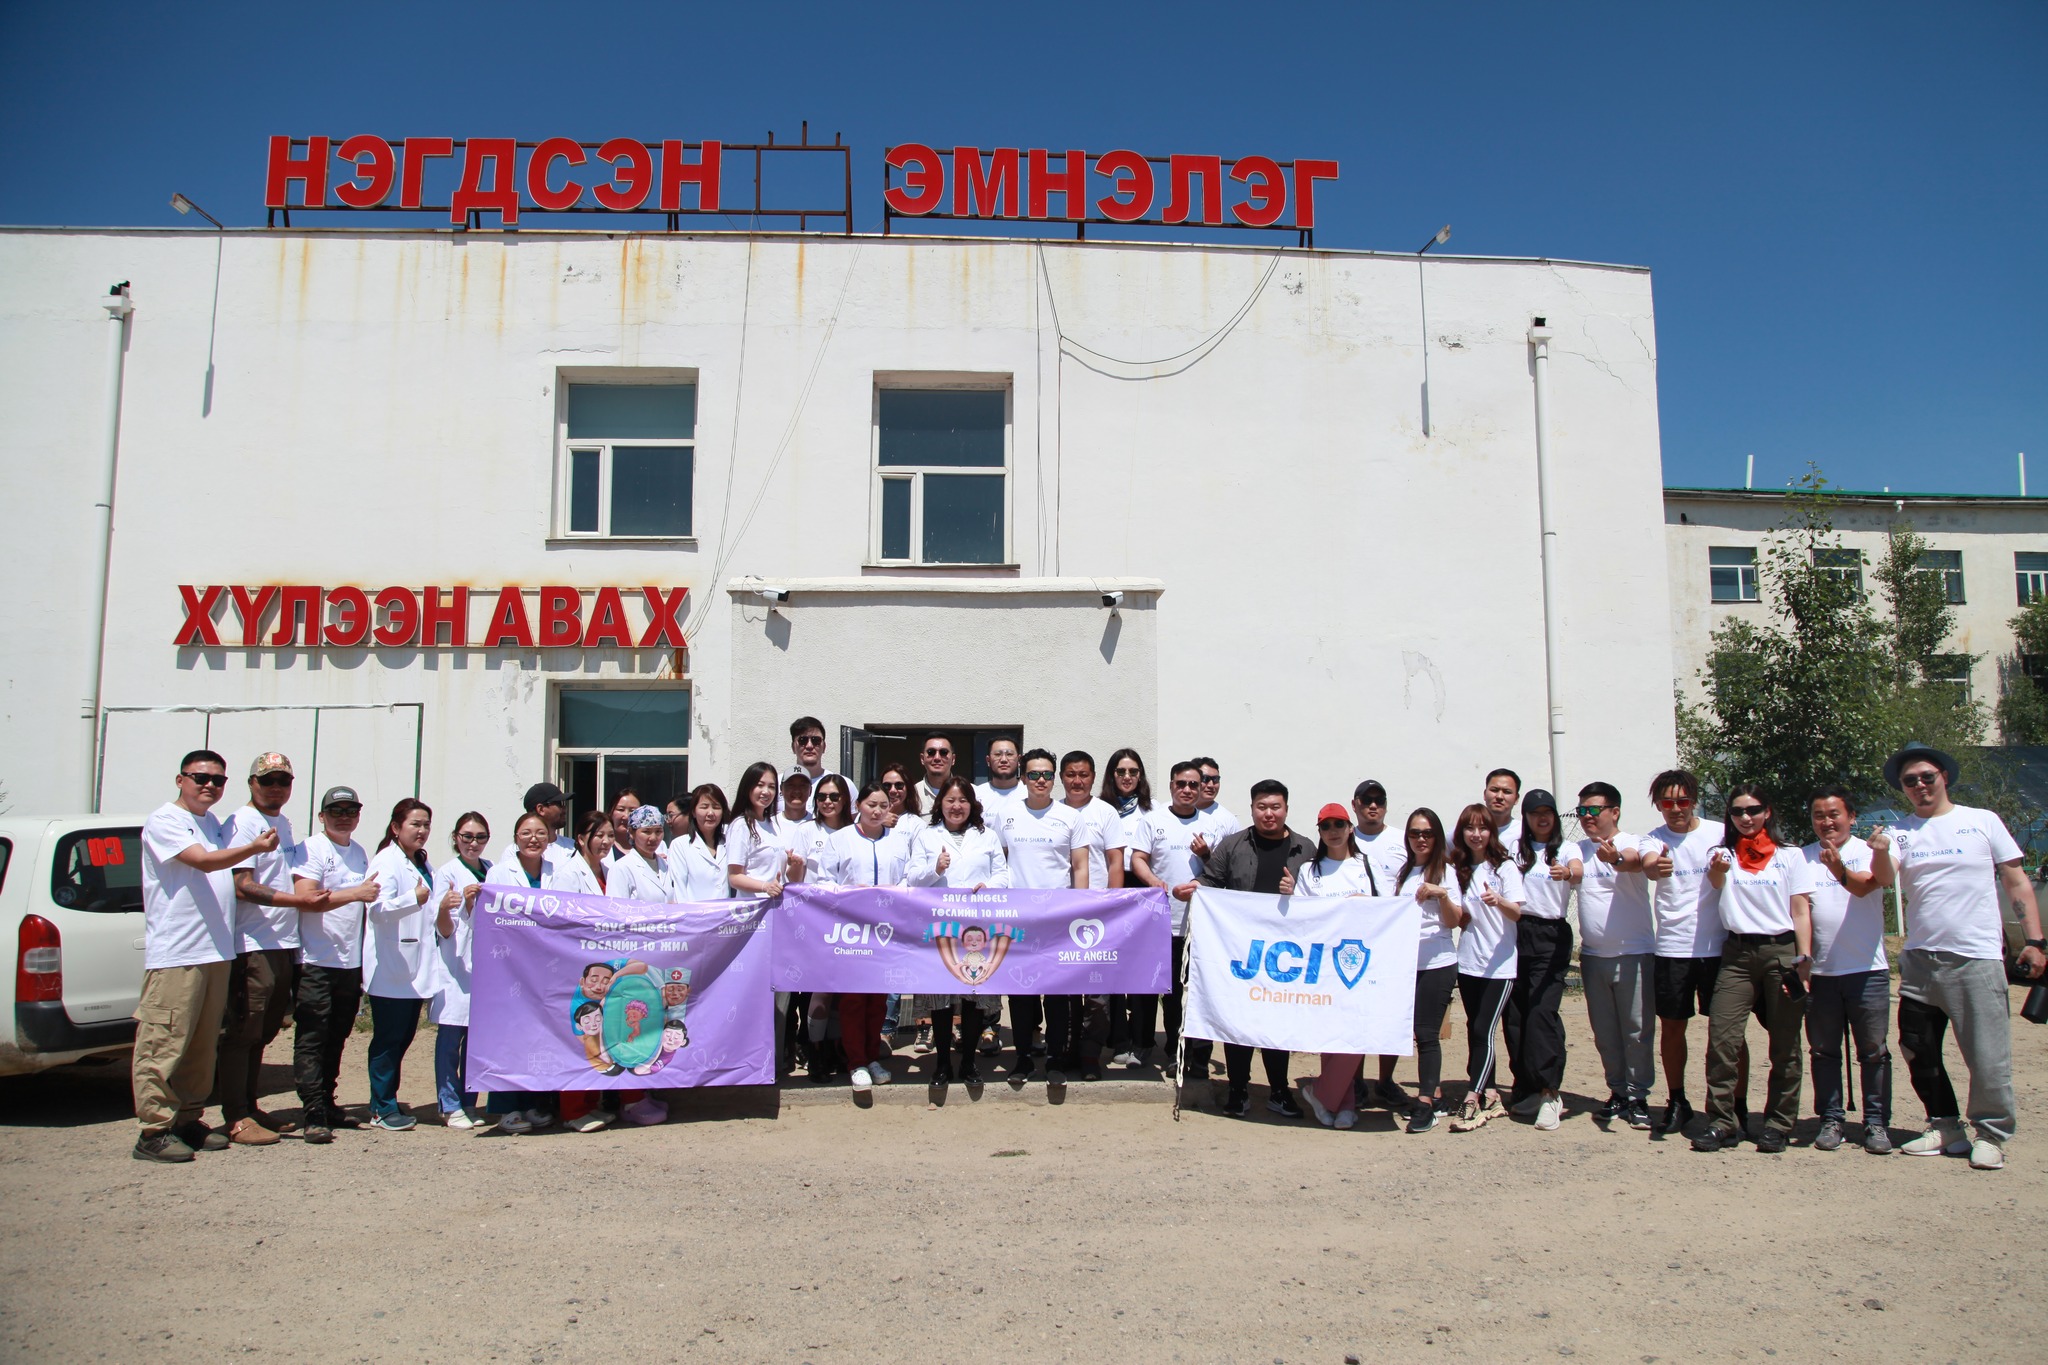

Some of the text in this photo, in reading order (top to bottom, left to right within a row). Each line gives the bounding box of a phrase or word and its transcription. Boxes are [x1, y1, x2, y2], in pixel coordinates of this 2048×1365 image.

[265, 134, 1339, 228] НЭГДСЭН ЭМНЭЛЭГ
[173, 584, 690, 649] ХҮЛЭЭН АВАХ
[75, 836, 125, 867] 103
[1911, 848, 1954, 859] BABY SHARK
[942, 893, 1008, 903] SAVE ANGELS
[484, 892, 536, 916] JCI
[931, 907, 1019, 918] ТӨСЛИЙН 10 ЖИЛ
[494, 917, 537, 927] Chairman
[594, 922, 677, 933] SAVE ANGELS
[718, 925, 738, 935] SAVE
[824, 922, 871, 944] JCI
[643, 941, 656, 951] 10
[660, 941, 689, 952] ЖИЛ
[833, 947, 873, 955] Chairman
[1058, 950, 1118, 962] SAVE ANGELS
[1230, 939, 1324, 984] JCI
[1248, 986, 1332, 1006] Chairman
